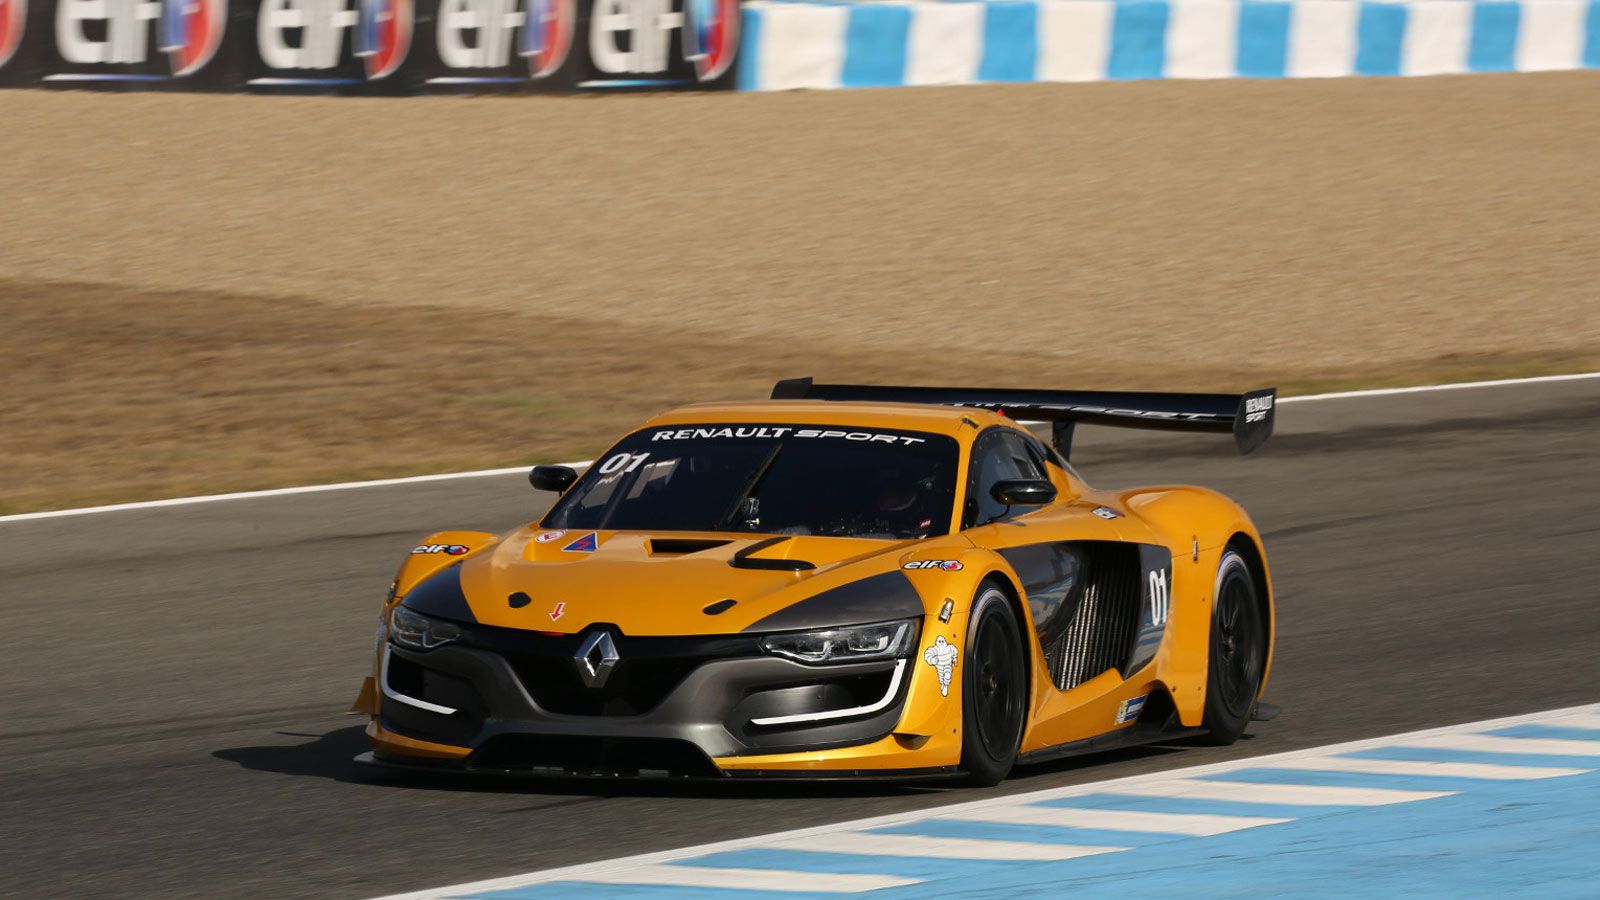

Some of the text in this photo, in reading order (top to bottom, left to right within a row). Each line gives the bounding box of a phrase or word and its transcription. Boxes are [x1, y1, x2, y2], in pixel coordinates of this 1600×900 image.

[651, 427, 925, 446] RENAULT SPORT
[599, 452, 651, 474] 01
[411, 544, 449, 554] elf
[903, 560, 943, 569] elf
[1149, 568, 1168, 626] 01
